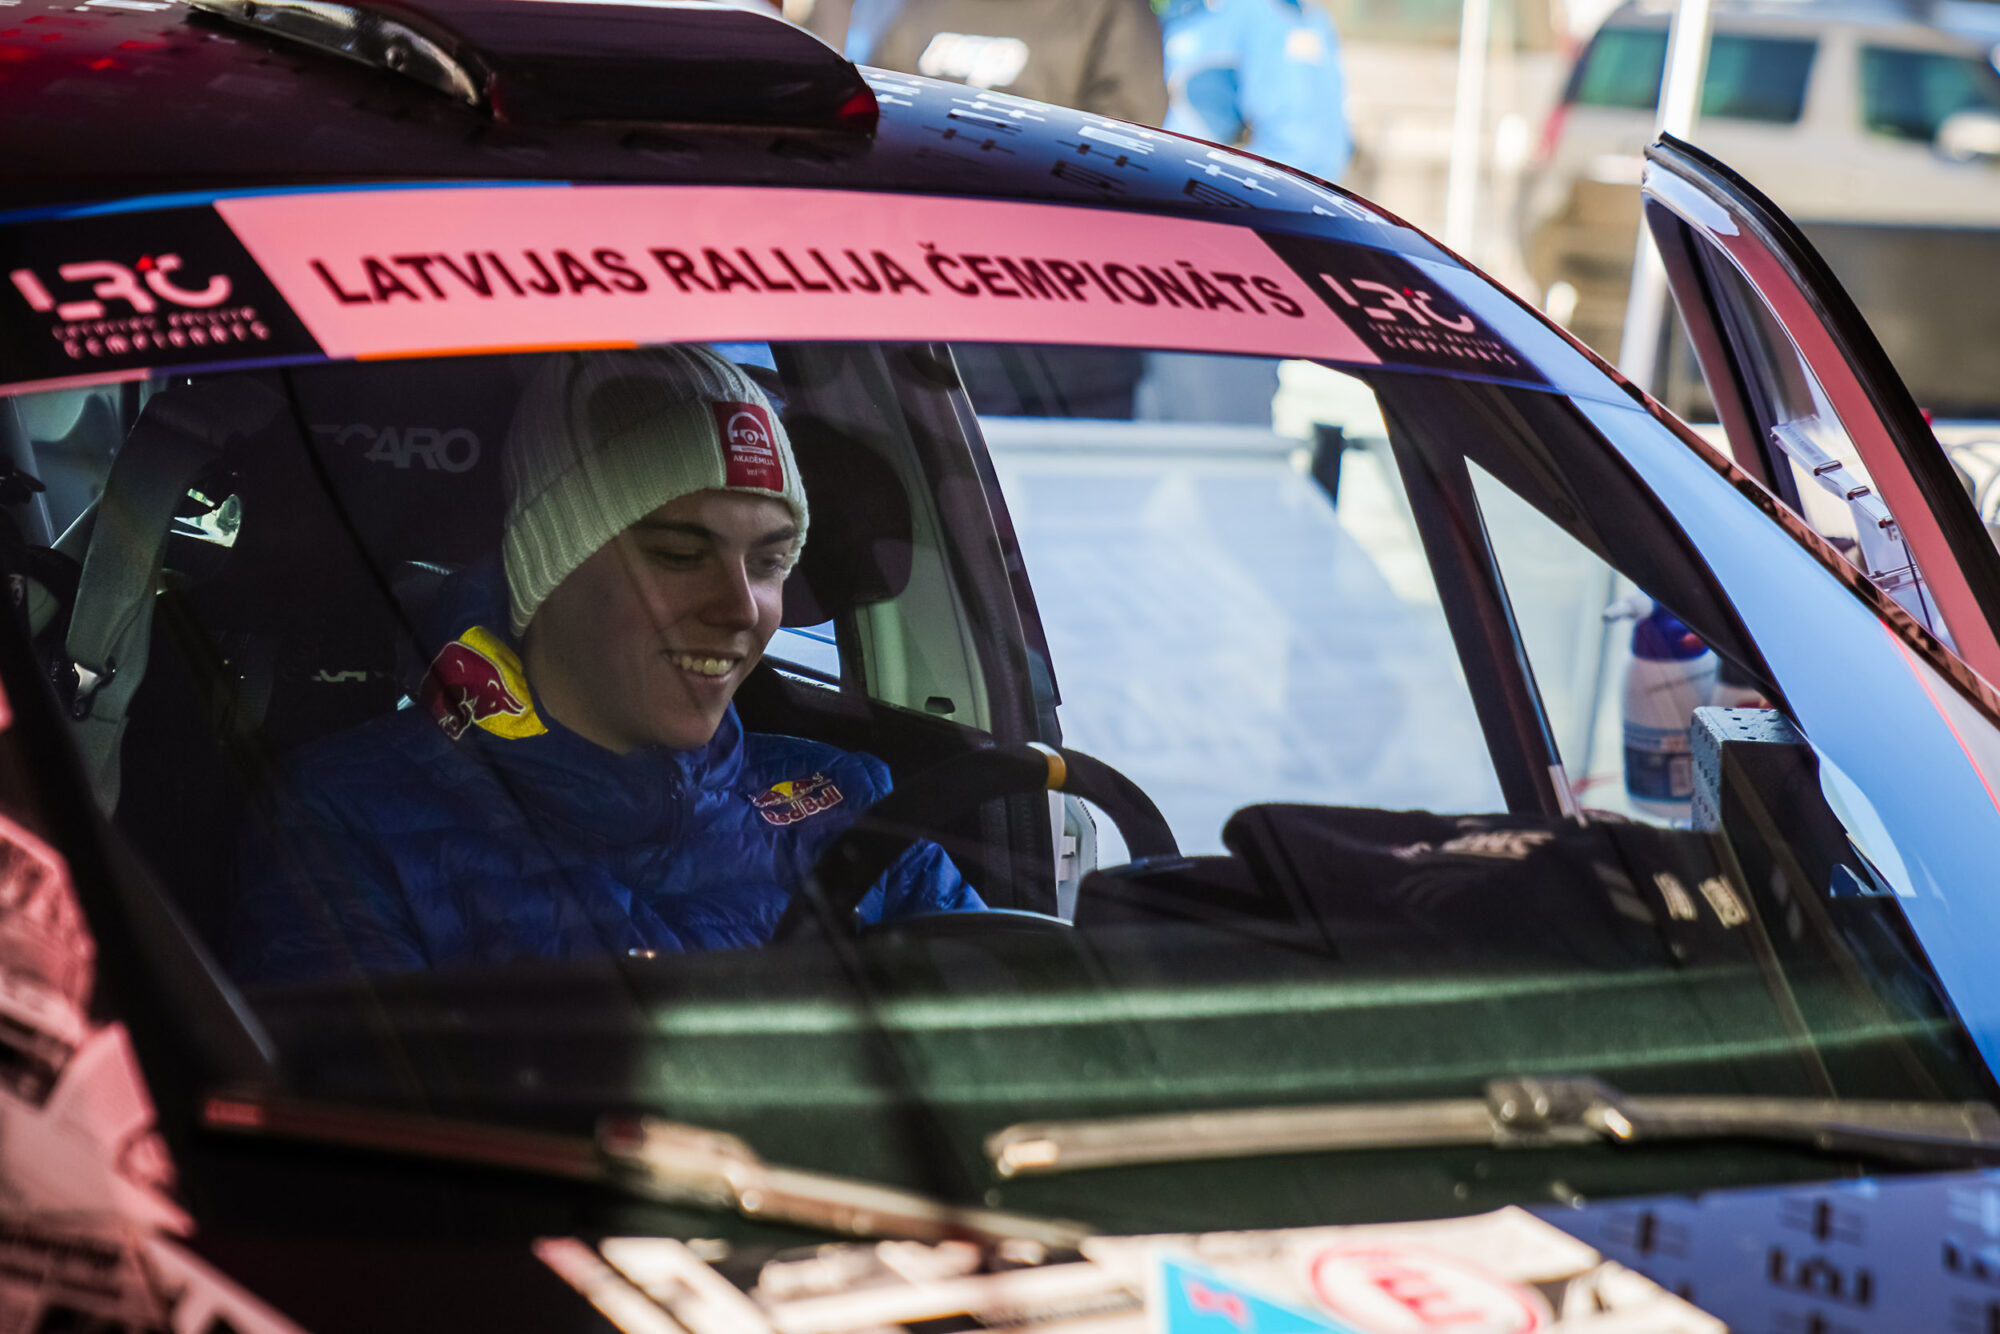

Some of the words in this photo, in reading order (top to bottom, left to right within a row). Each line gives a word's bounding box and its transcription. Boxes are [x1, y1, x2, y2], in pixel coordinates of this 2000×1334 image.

[10, 254, 232, 321] LRC
[309, 249, 649, 304] LATVIJAS
[649, 247, 930, 294] RALLIJA
[917, 241, 1305, 319] ČEMPIONĀTS
[1319, 273, 1475, 333] LRC
[309, 423, 480, 473] CARO
[760, 799, 807, 825] Red
[799, 785, 843, 815] Bull
